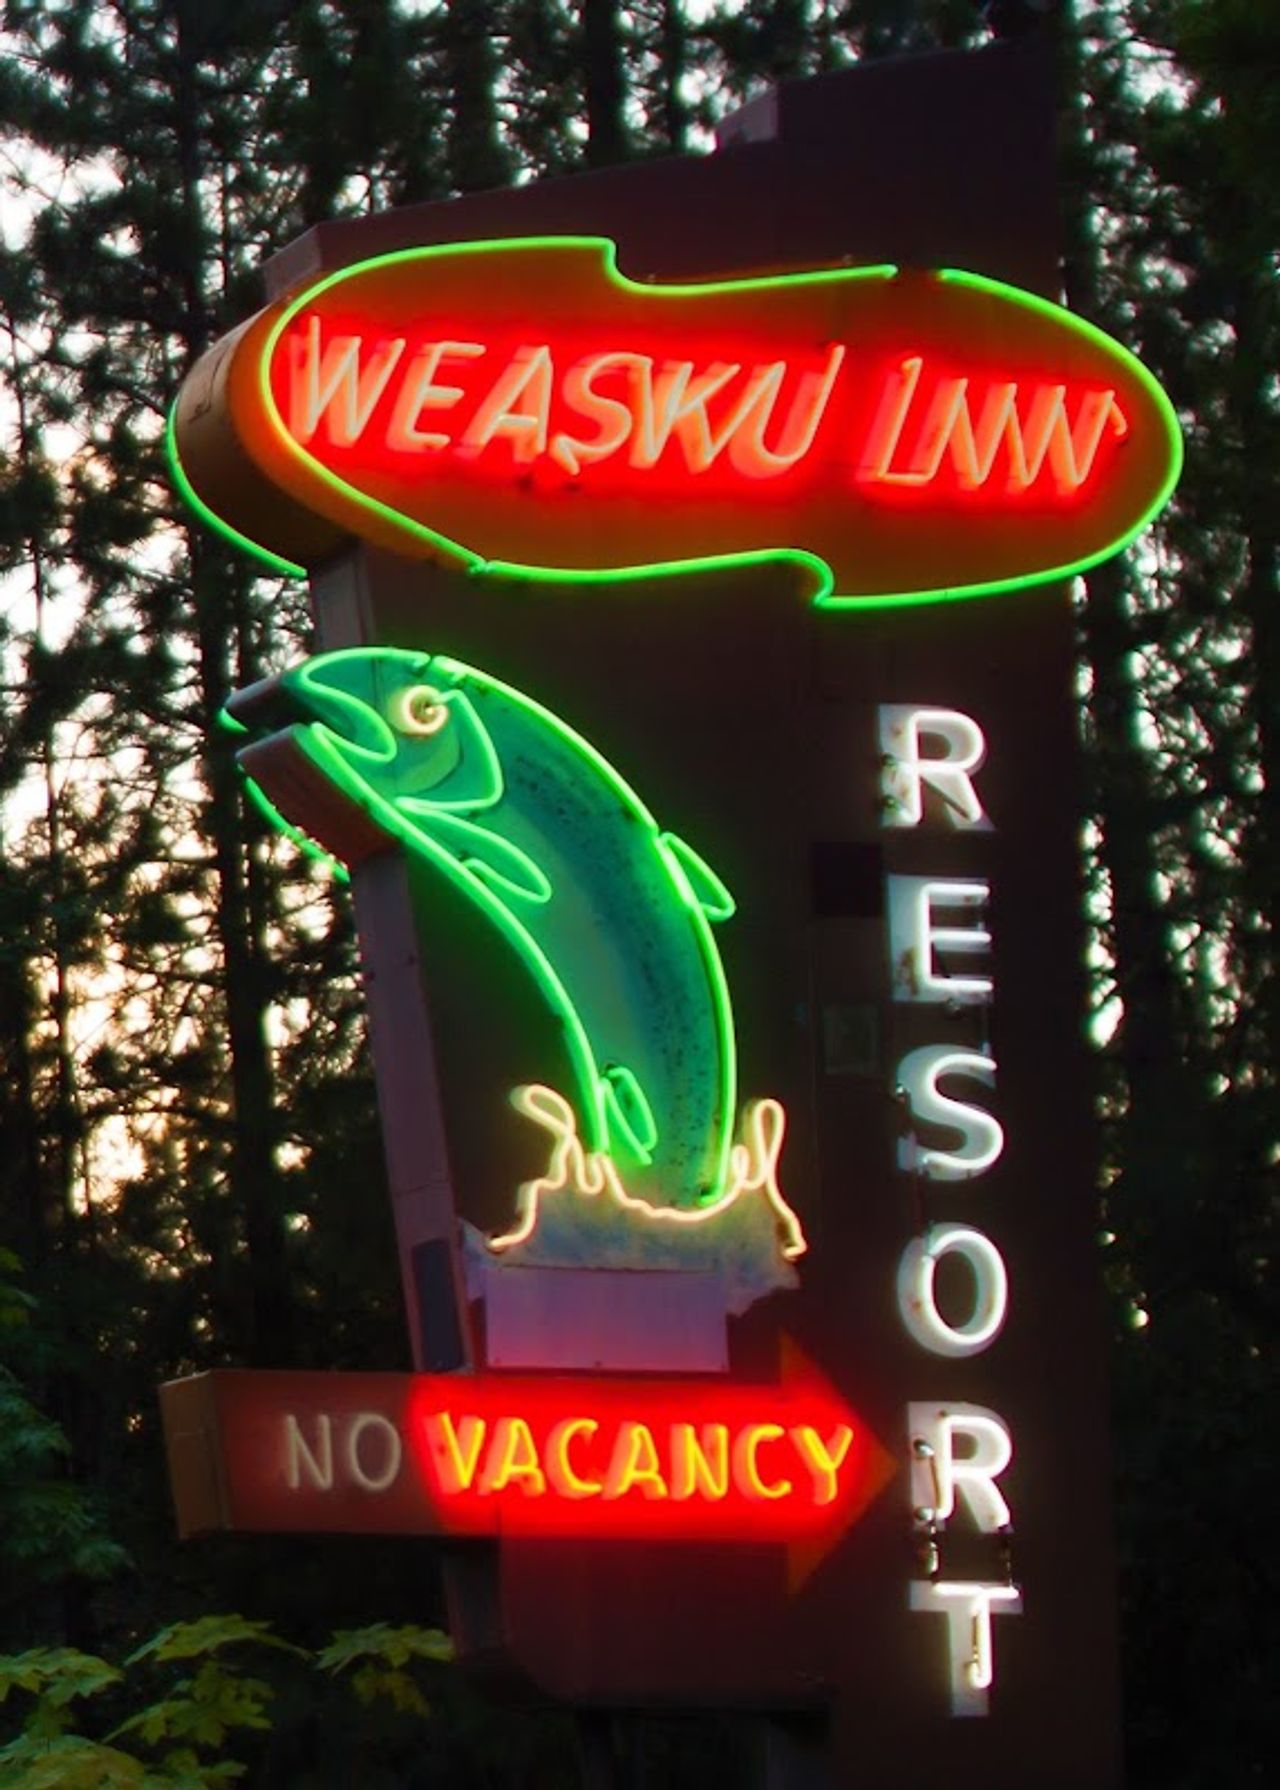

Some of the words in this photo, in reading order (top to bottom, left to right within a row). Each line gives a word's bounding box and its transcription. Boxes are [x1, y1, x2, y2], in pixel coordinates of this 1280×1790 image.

[290, 315, 845, 475] WEASKU
[858, 357, 1128, 490] INN
[878, 703, 1022, 1717] RESORT
[283, 1413, 402, 1492] NO
[427, 1410, 854, 1505] VACANCY
